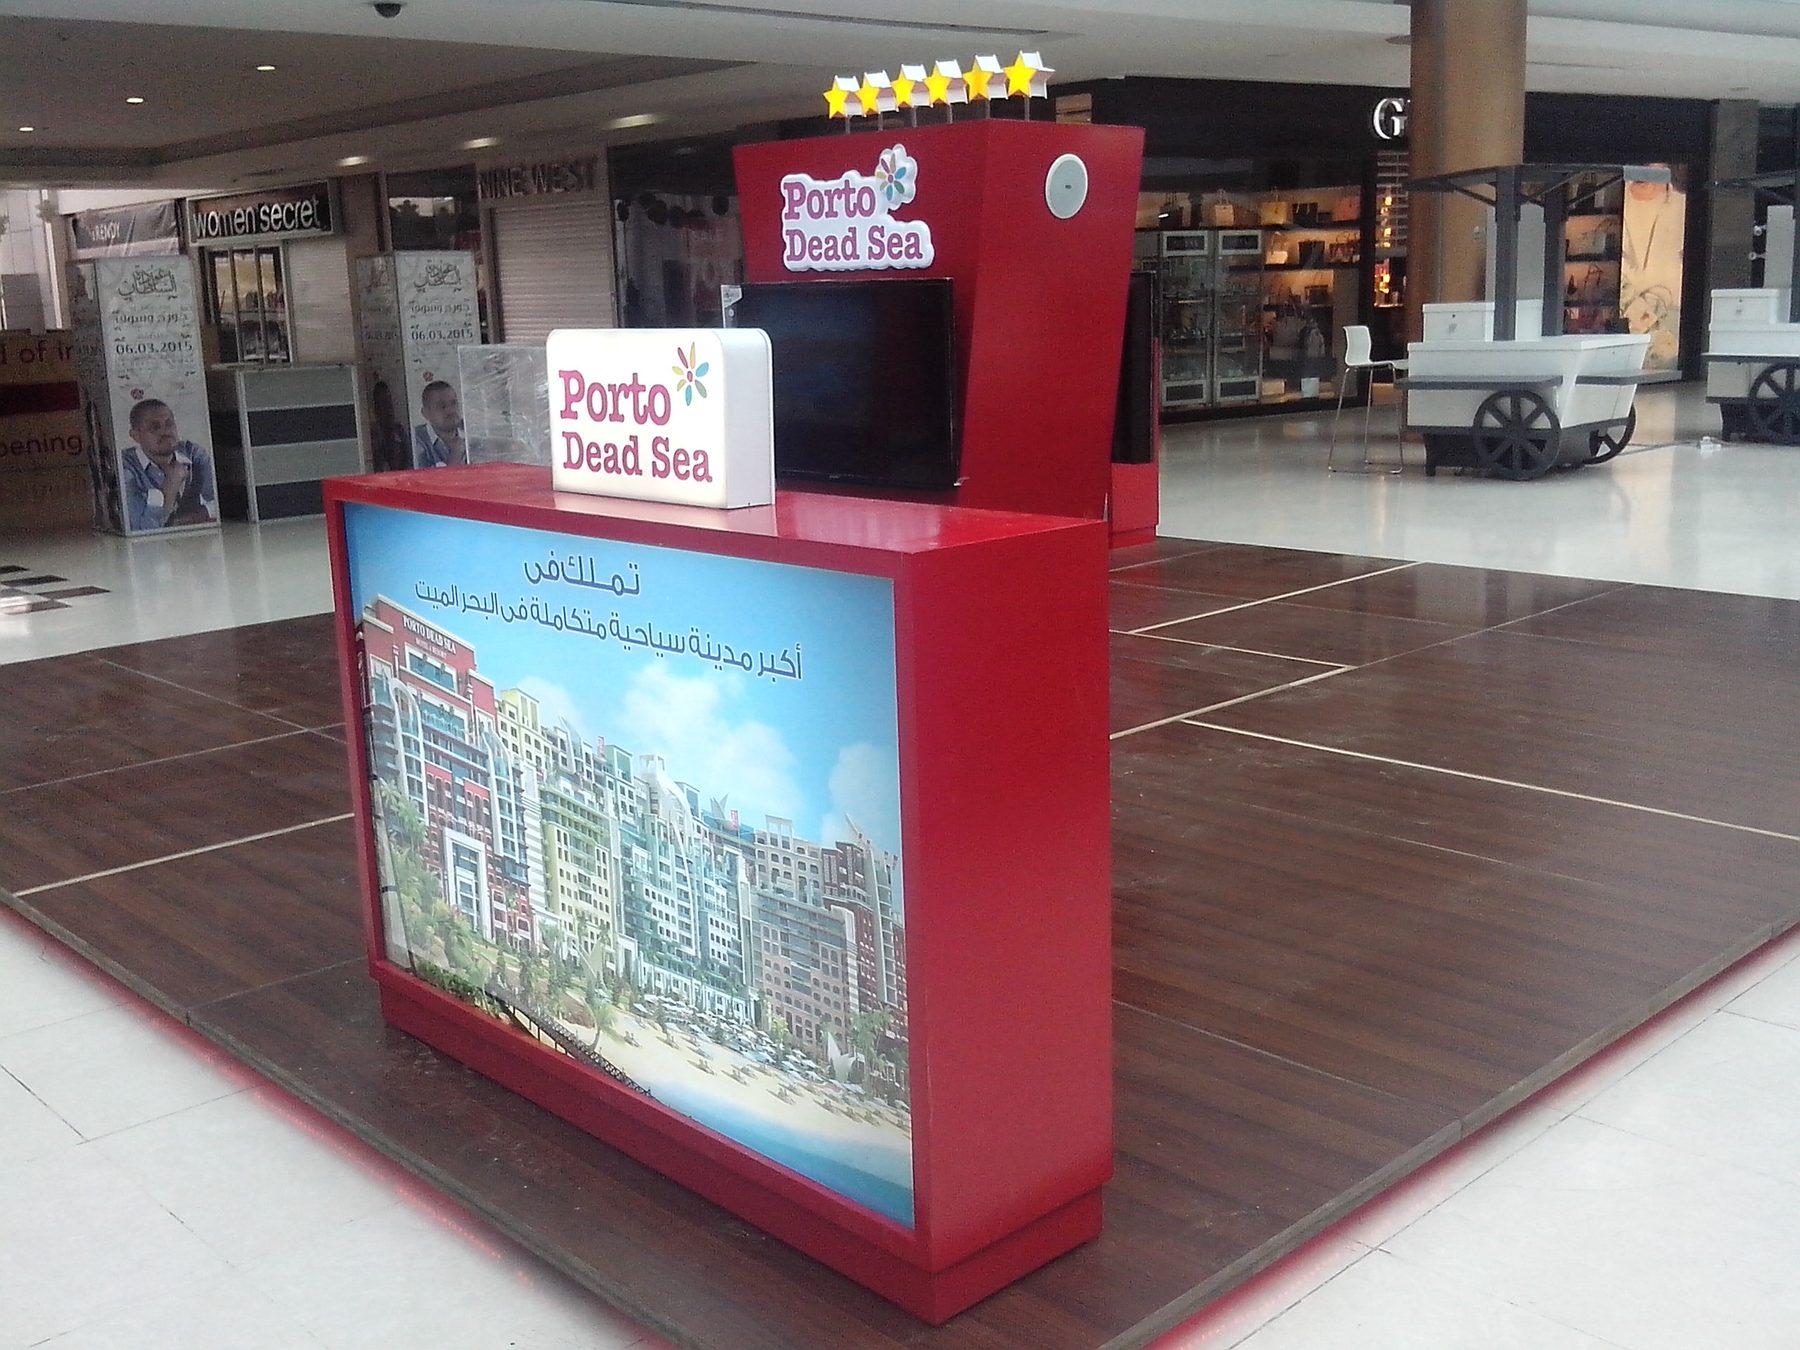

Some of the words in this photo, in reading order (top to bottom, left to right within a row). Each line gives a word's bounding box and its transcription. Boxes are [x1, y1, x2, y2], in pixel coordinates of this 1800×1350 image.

[784, 179, 877, 220] Porto
[786, 226, 860, 262] Dead
[868, 225, 923, 261] Sea
[19, 339, 47, 363] of
[115, 341, 194, 355] 06.03.2015
[410, 329, 474, 341] 06.03.2015
[558, 369, 671, 426] Porto
[562, 431, 643, 476] Dead
[651, 436, 713, 483] Sea
[414, 580, 460, 610] الميت
[461, 592, 501, 622] البحر
[530, 596, 607, 641] متكاملة
[608, 610, 687, 659] سياحية
[688, 626, 754, 672] مدينة
[757, 642, 803, 683] أكبر
